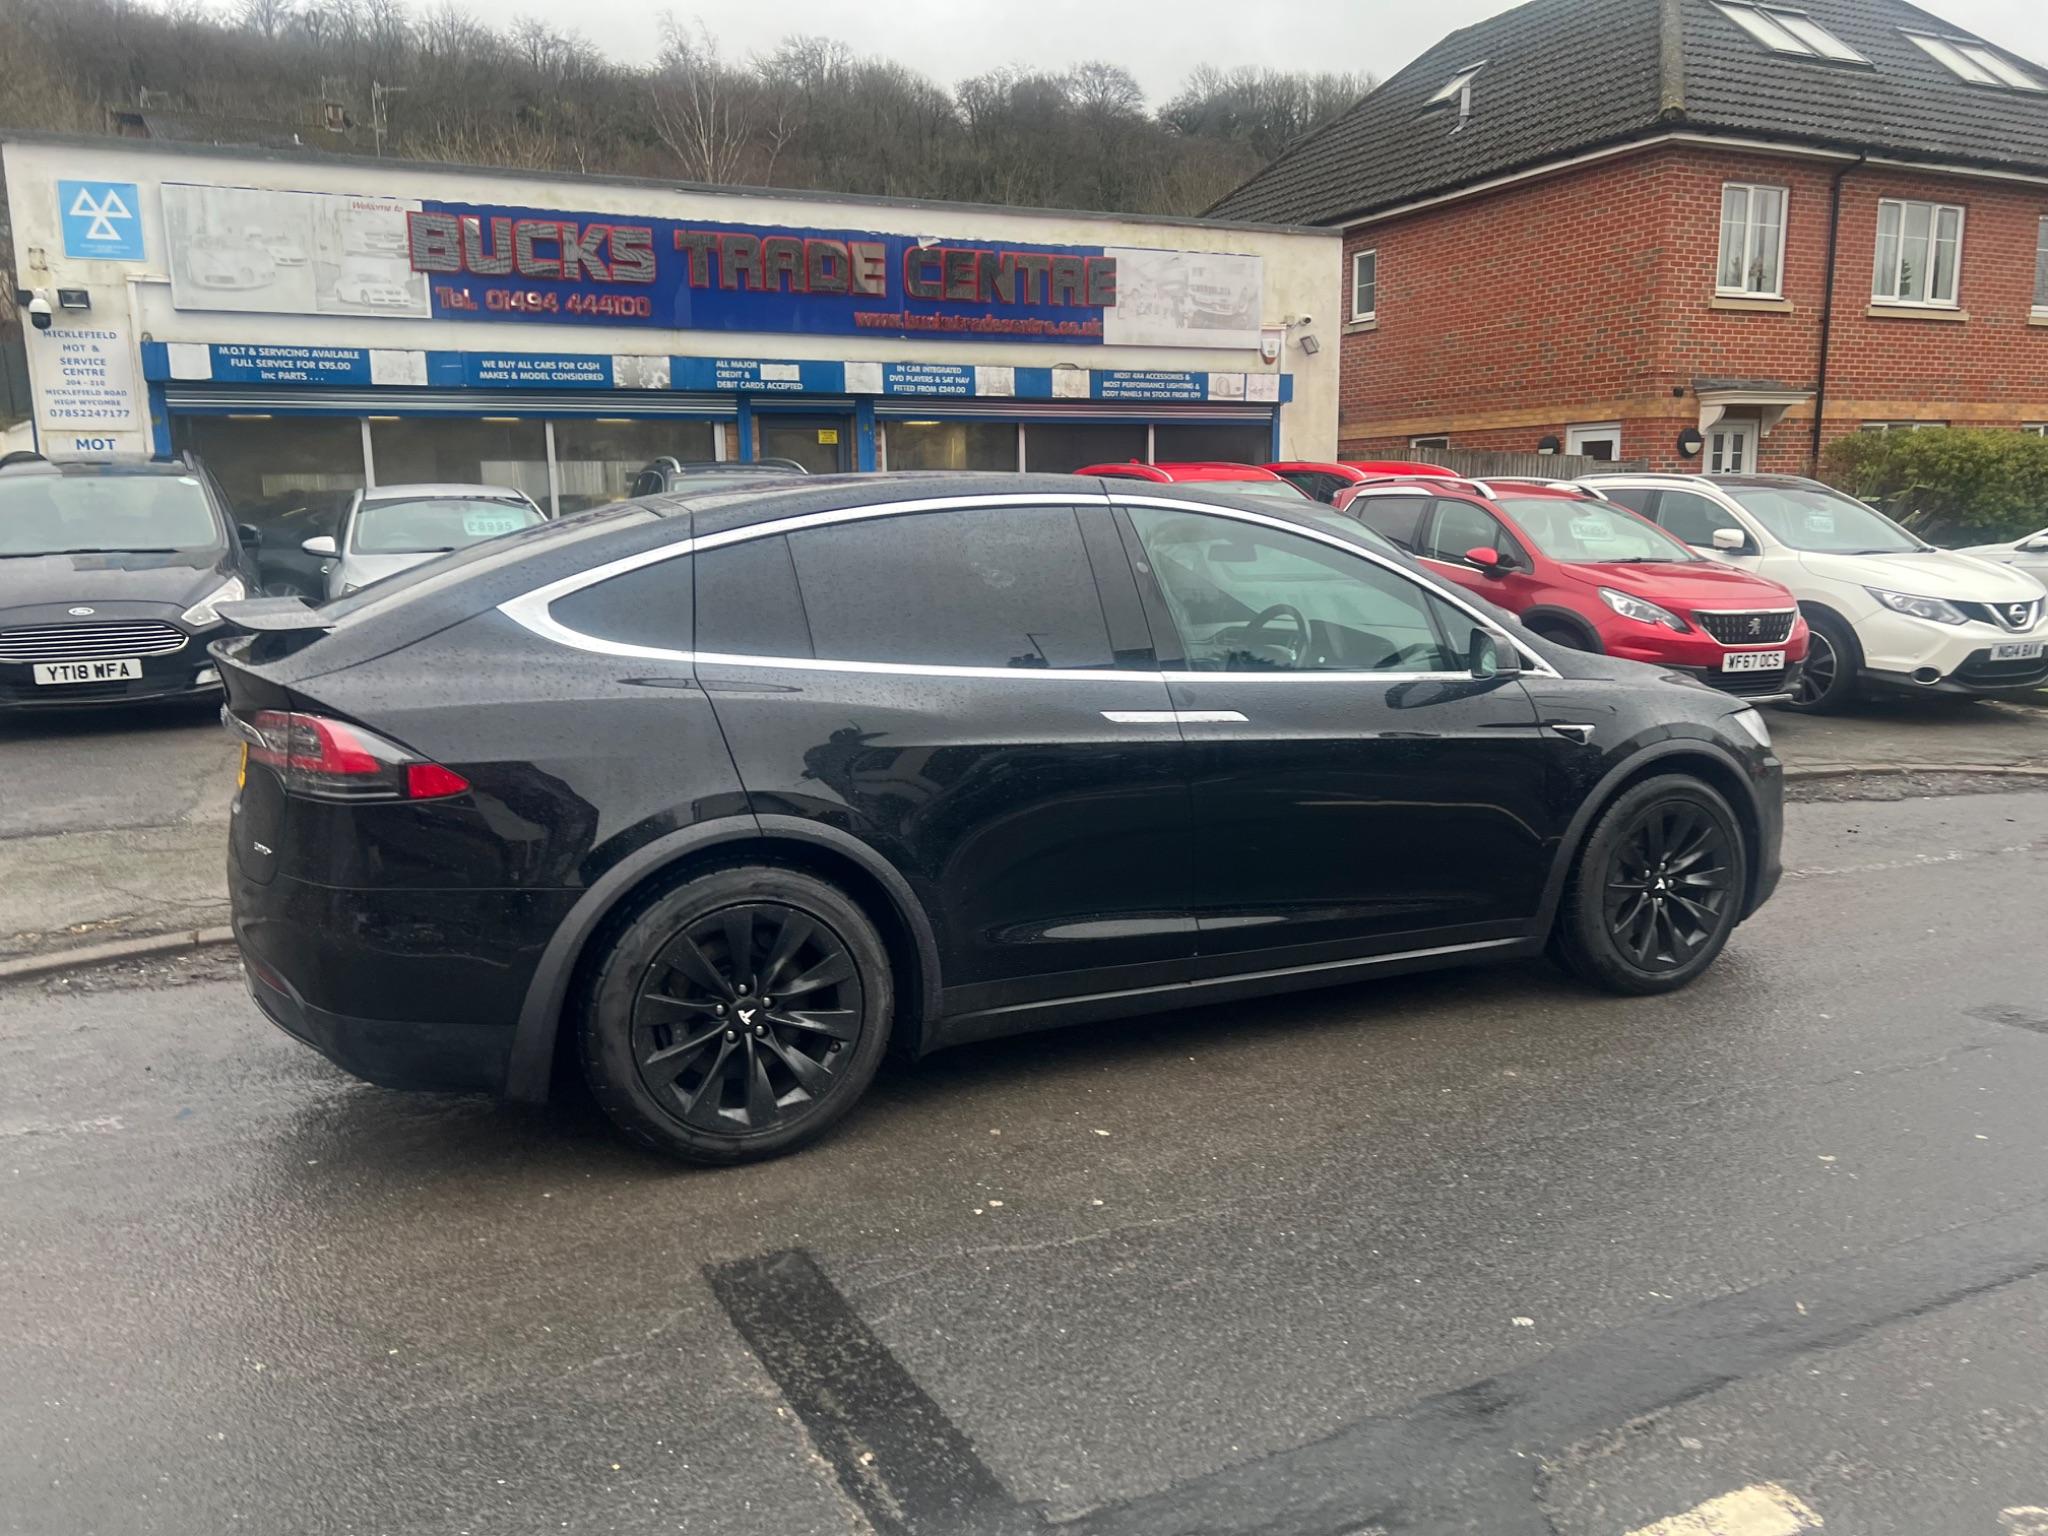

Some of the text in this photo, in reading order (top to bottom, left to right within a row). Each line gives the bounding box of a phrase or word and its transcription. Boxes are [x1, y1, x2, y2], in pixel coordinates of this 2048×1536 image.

[407, 211, 1117, 307] BUCKS TRADE CENTRE
[485, 288, 559, 314] 01494
[564, 292, 652, 317] 444100
[42, 329, 117, 340] MICKLEFIELD
[62, 344, 100, 353] MOT &
[248, 347, 257, 356] &
[259, 347, 310, 358] SERVICING
[311, 349, 360, 360] AVAILABLE
[59, 357, 107, 367] SERVICE
[230, 358, 254, 367] FULL
[256, 359, 294, 369] SERVICE
[296, 360, 316, 370] FOR
[481, 360, 600, 371] WE BUY ALL CARS FOR CASH
[715, 360, 758, 369] ALL MAJOR
[62, 368, 106, 377] CENTRE
[261, 370, 276, 380] inc
[278, 371, 308, 381] PARTS
[479, 371, 605, 381] MAKES & MODEL CONSIDERED
[716, 370, 751, 379] CREDIT &
[716, 380, 804, 390] DEBIT CARDS ACCEPTED
[45, 388, 128, 397] MICKLEFIELD ROAD
[78, 399, 122, 407] WYCOMBE
[76, 438, 116, 451] MOT
[1728, 654, 1758, 669] WF67
[47, 664, 89, 681] YT18
